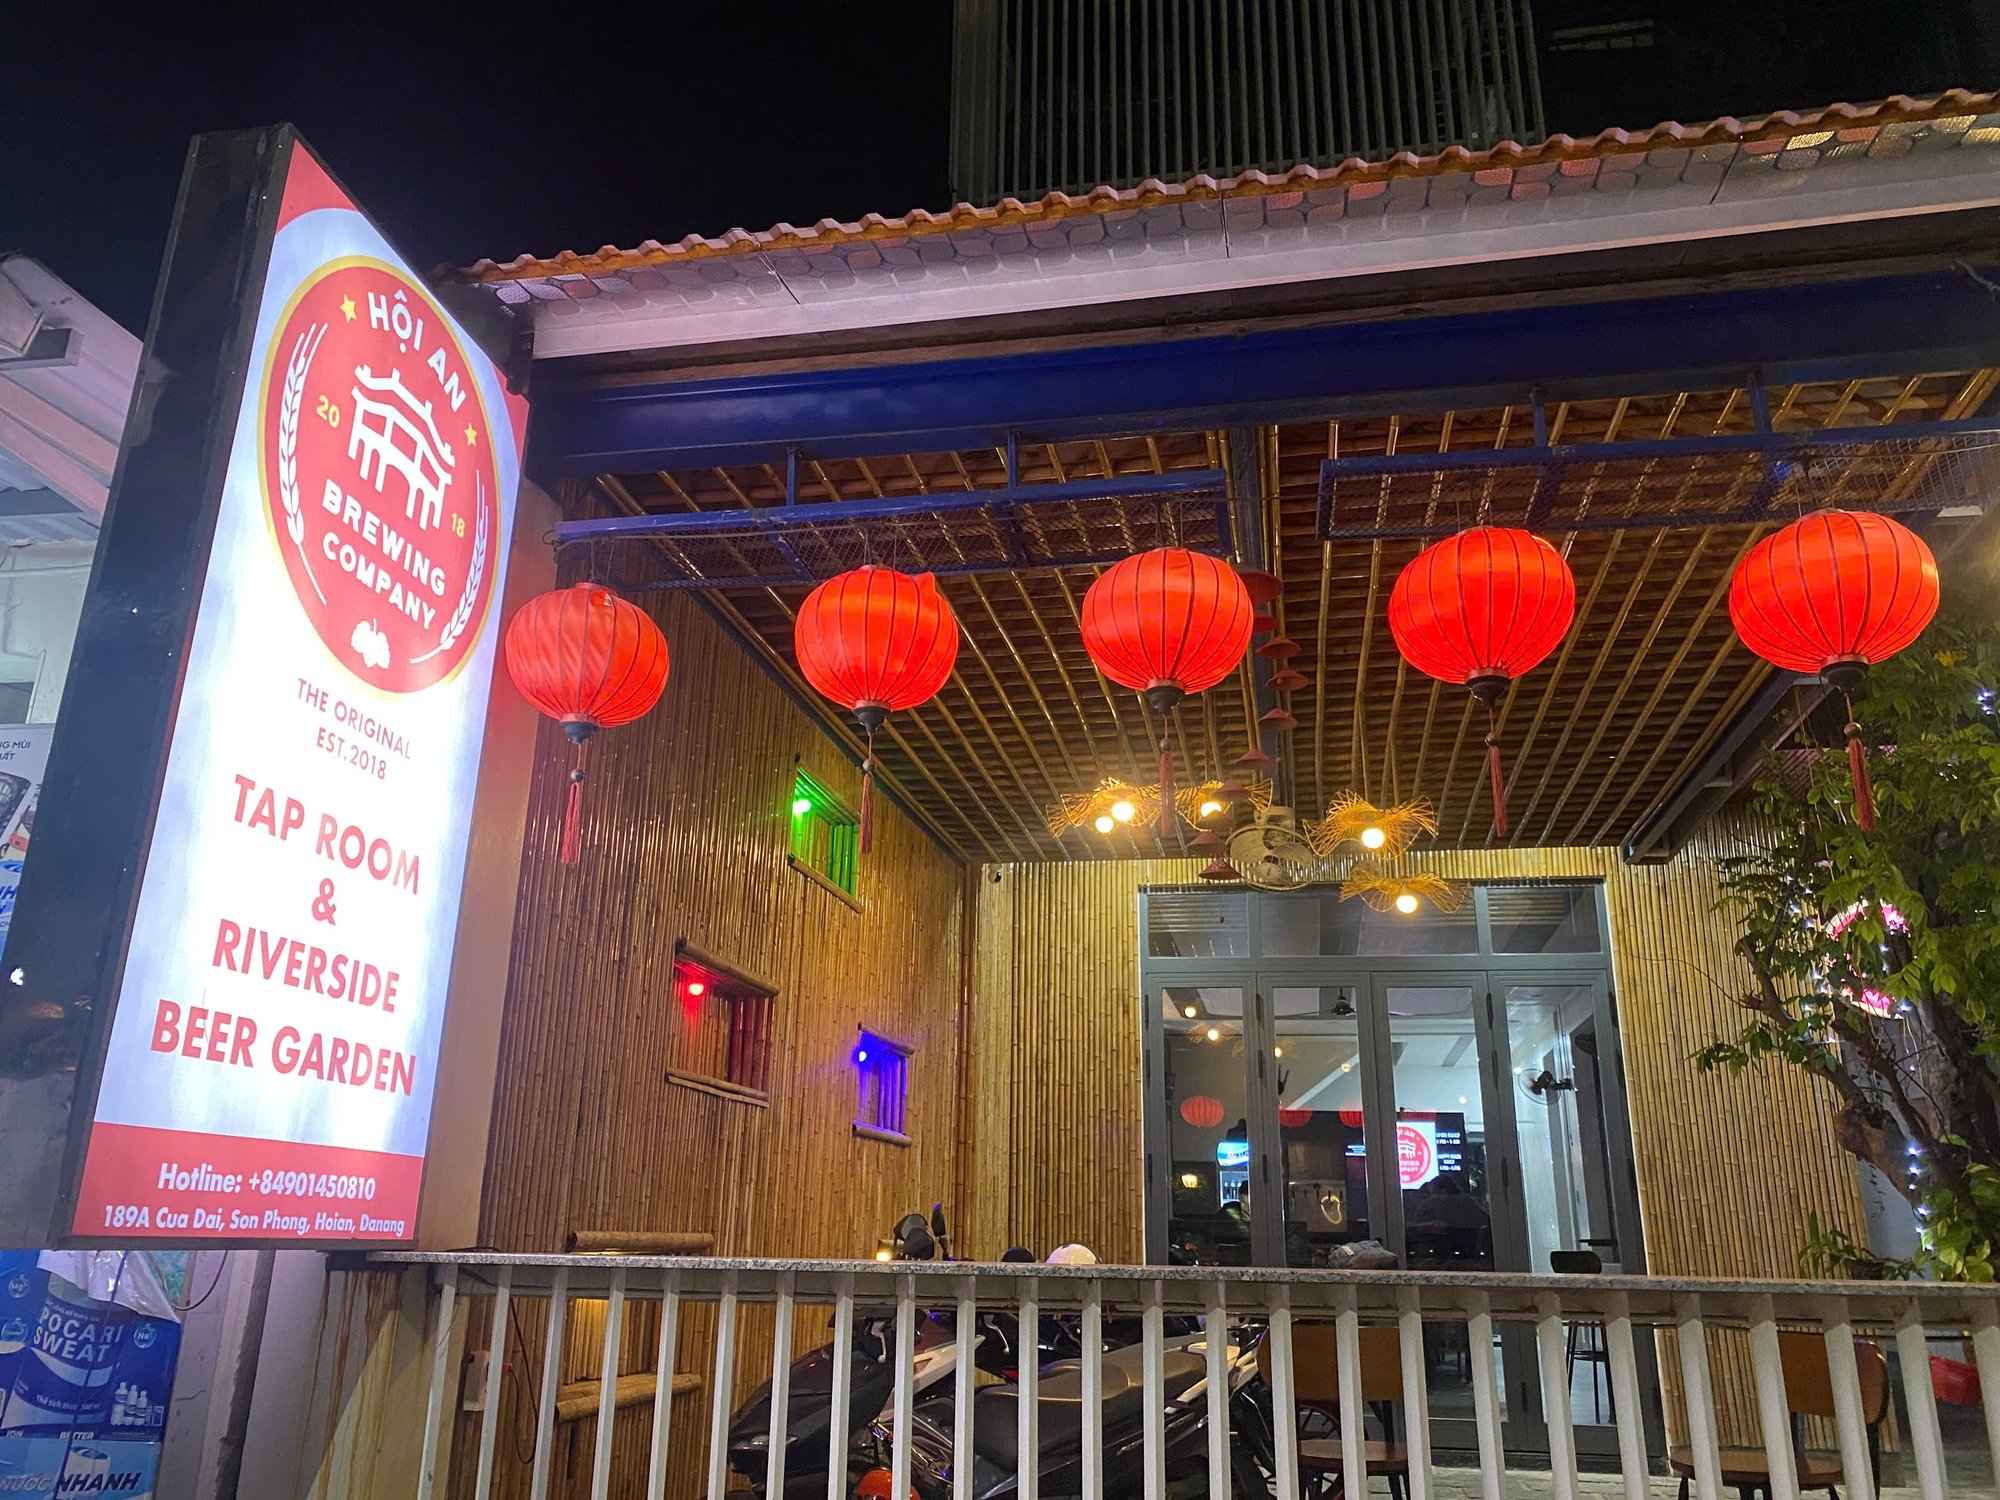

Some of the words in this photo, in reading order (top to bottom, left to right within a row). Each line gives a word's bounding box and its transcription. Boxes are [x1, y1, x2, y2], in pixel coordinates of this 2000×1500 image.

[368, 289, 423, 354] HỘI
[427, 347, 466, 413] AN
[316, 394, 340, 429] 20
[322, 478, 445, 596] BREWING
[451, 512, 466, 538] 18
[322, 531, 436, 630] COMPANY
[298, 678, 329, 713] THE
[334, 701, 410, 760] ORIGINAL
[317, 726, 387, 780] EST.2018
[234, 773, 305, 841] TAP
[315, 812, 420, 895] ROOM
[311, 877, 337, 927] &
[212, 918, 399, 1014] RIVERSIDE
[151, 998, 258, 1068] BEER
[271, 1025, 417, 1097] GARDEN
[157, 1162, 243, 1194] Hotline:
[248, 1169, 376, 1201] +84901450810
[103, 1205, 149, 1229] 189A
[155, 1206, 188, 1229] Cua
[192, 1207, 225, 1233] Dai,
[229, 1209, 258, 1230] Son
[262, 1210, 311, 1236] Phong,
[314, 1212, 356, 1235] Hoian,
[359, 1214, 405, 1237] Danang
[33, 1325, 111, 1363] SWEAT
[39, 1305, 124, 1344] POCARI
